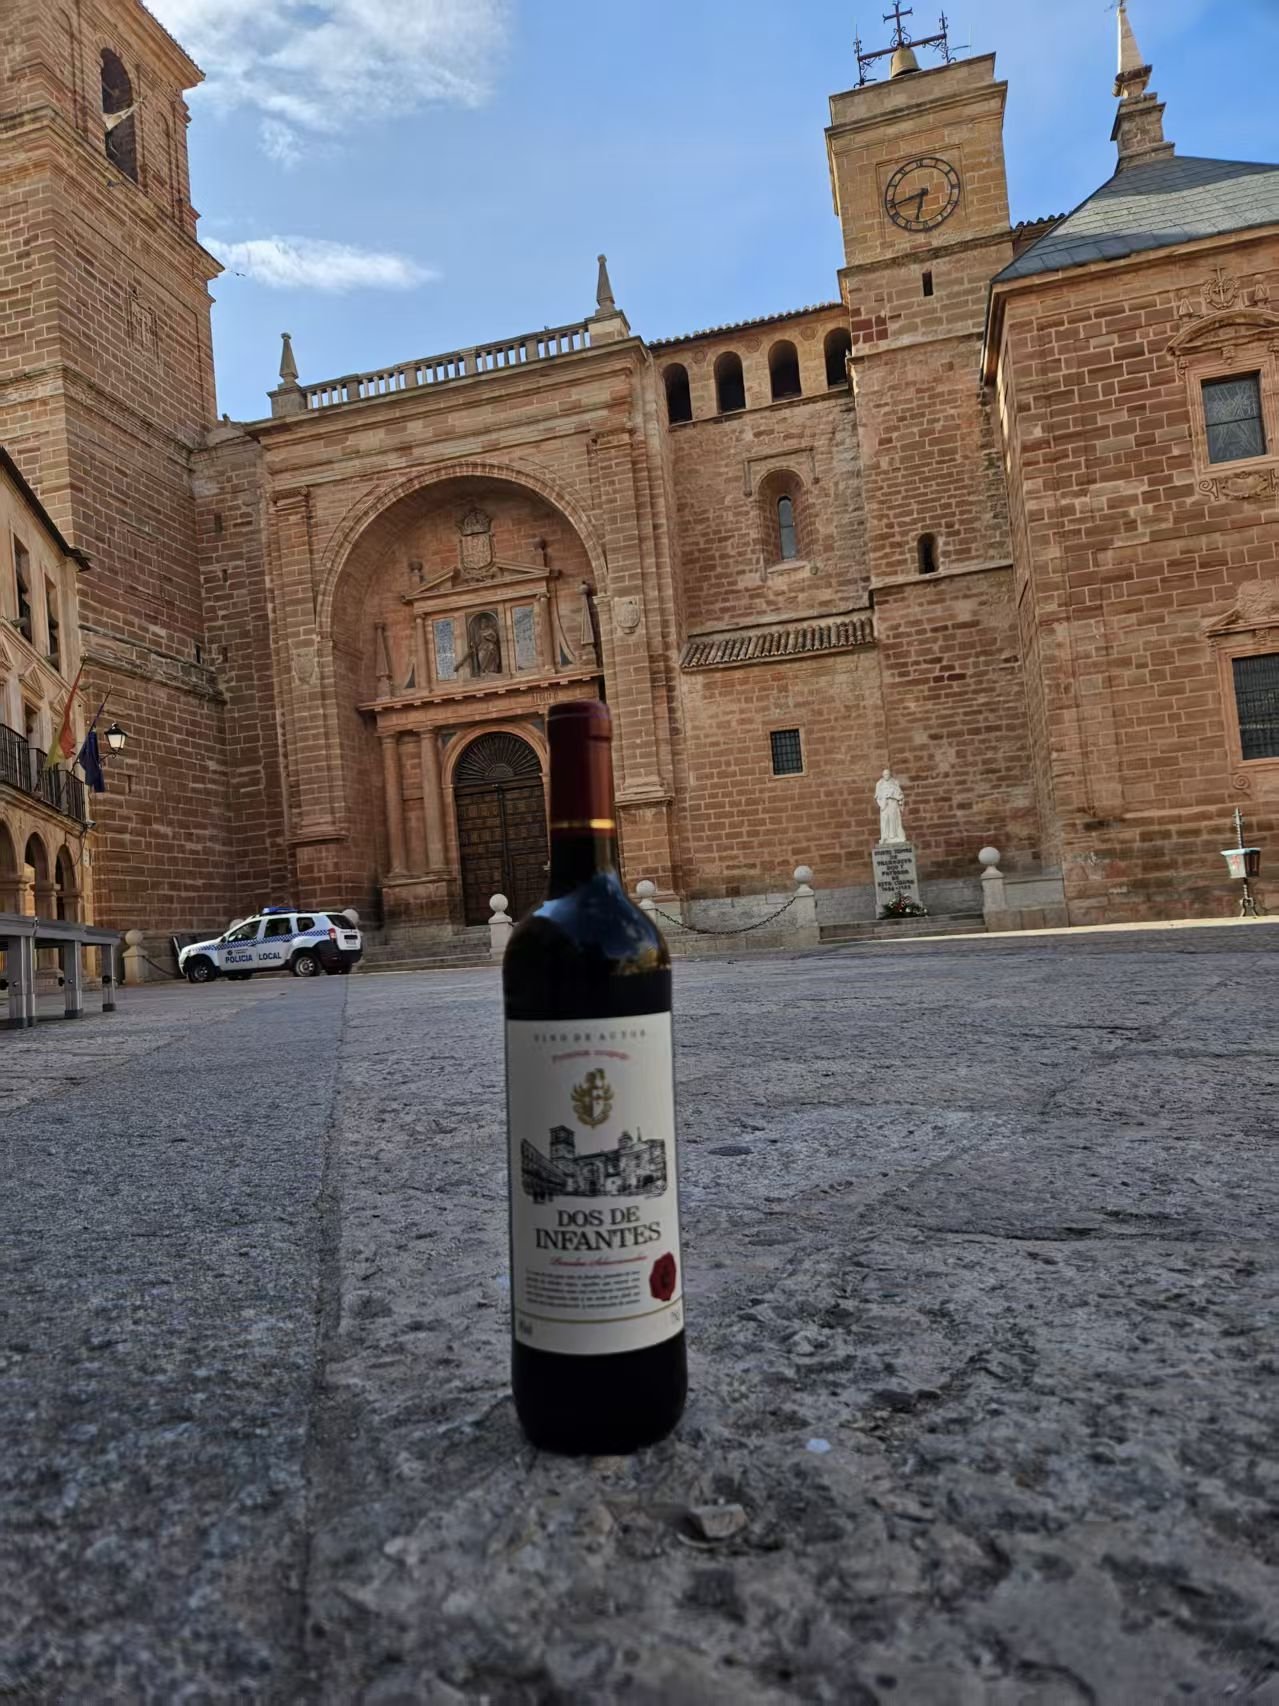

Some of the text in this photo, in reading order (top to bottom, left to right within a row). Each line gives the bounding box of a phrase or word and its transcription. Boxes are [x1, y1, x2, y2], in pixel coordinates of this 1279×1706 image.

[225, 952, 282, 964] POLICIA LOCAL
[557, 1205, 640, 1227] DOS DE
[535, 1222, 661, 1250] INFANTES
